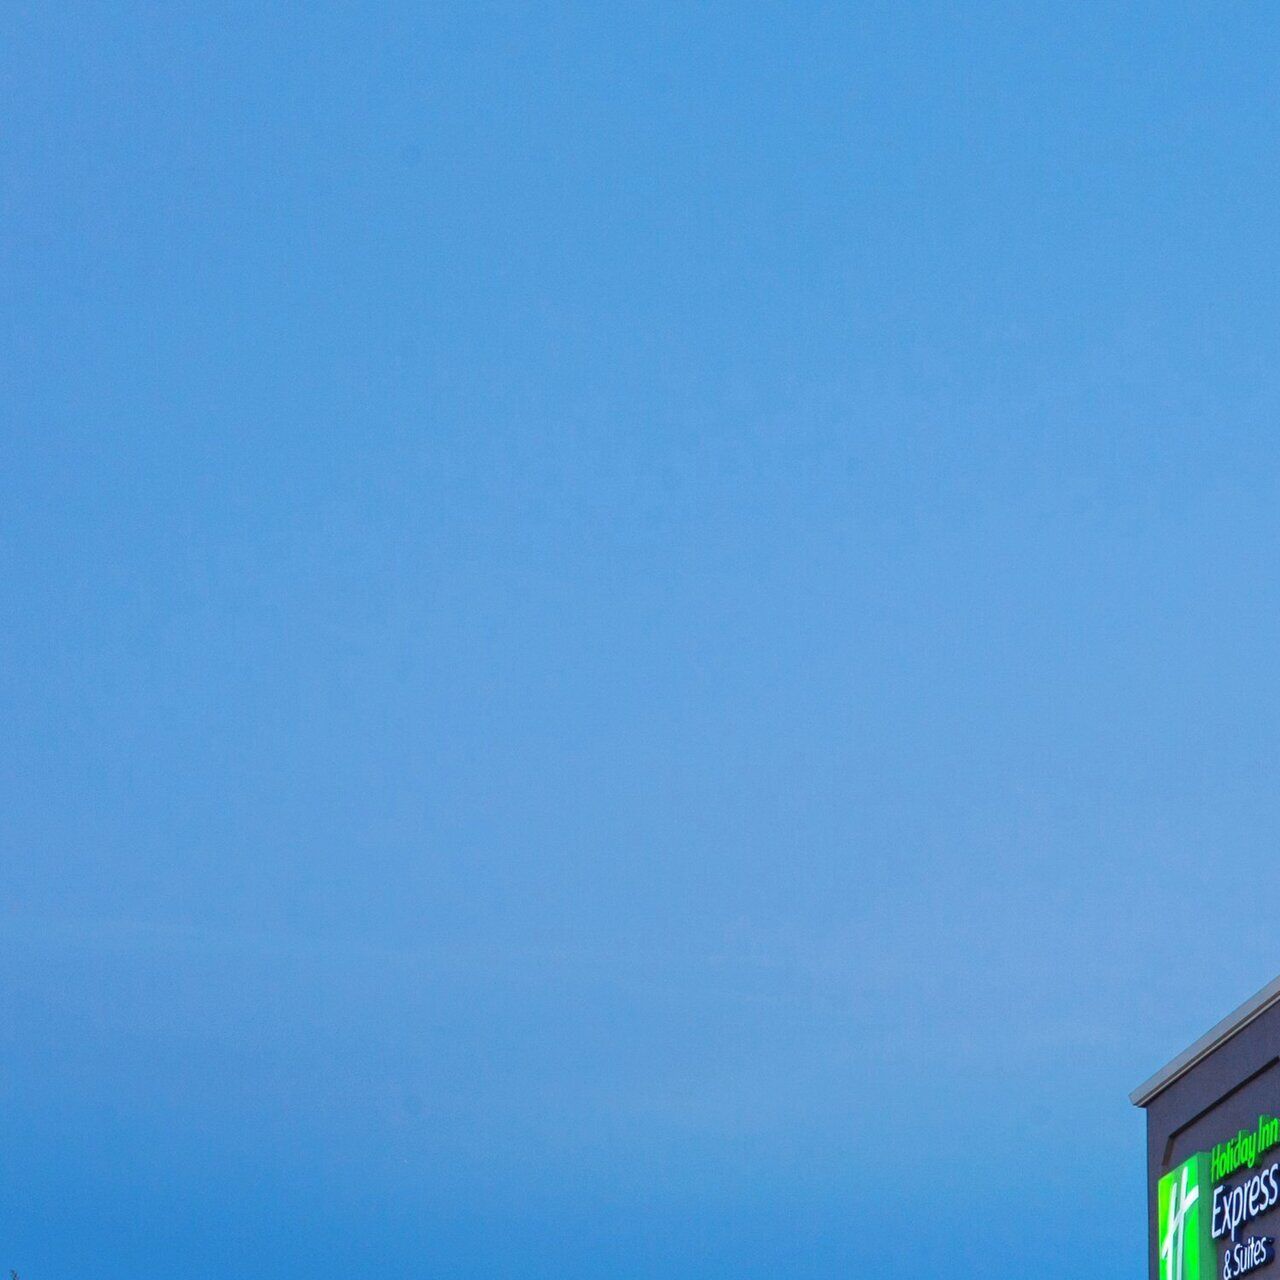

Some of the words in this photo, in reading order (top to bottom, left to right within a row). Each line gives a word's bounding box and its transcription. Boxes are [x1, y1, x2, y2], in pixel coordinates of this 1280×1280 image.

[1211, 1131, 1257, 1181] Holiday
[1258, 1115, 1280, 1151] Inn
[1211, 1163, 1280, 1241] Express
[1223, 1251, 1232, 1280] &
[1234, 1236, 1266, 1275] Suites
